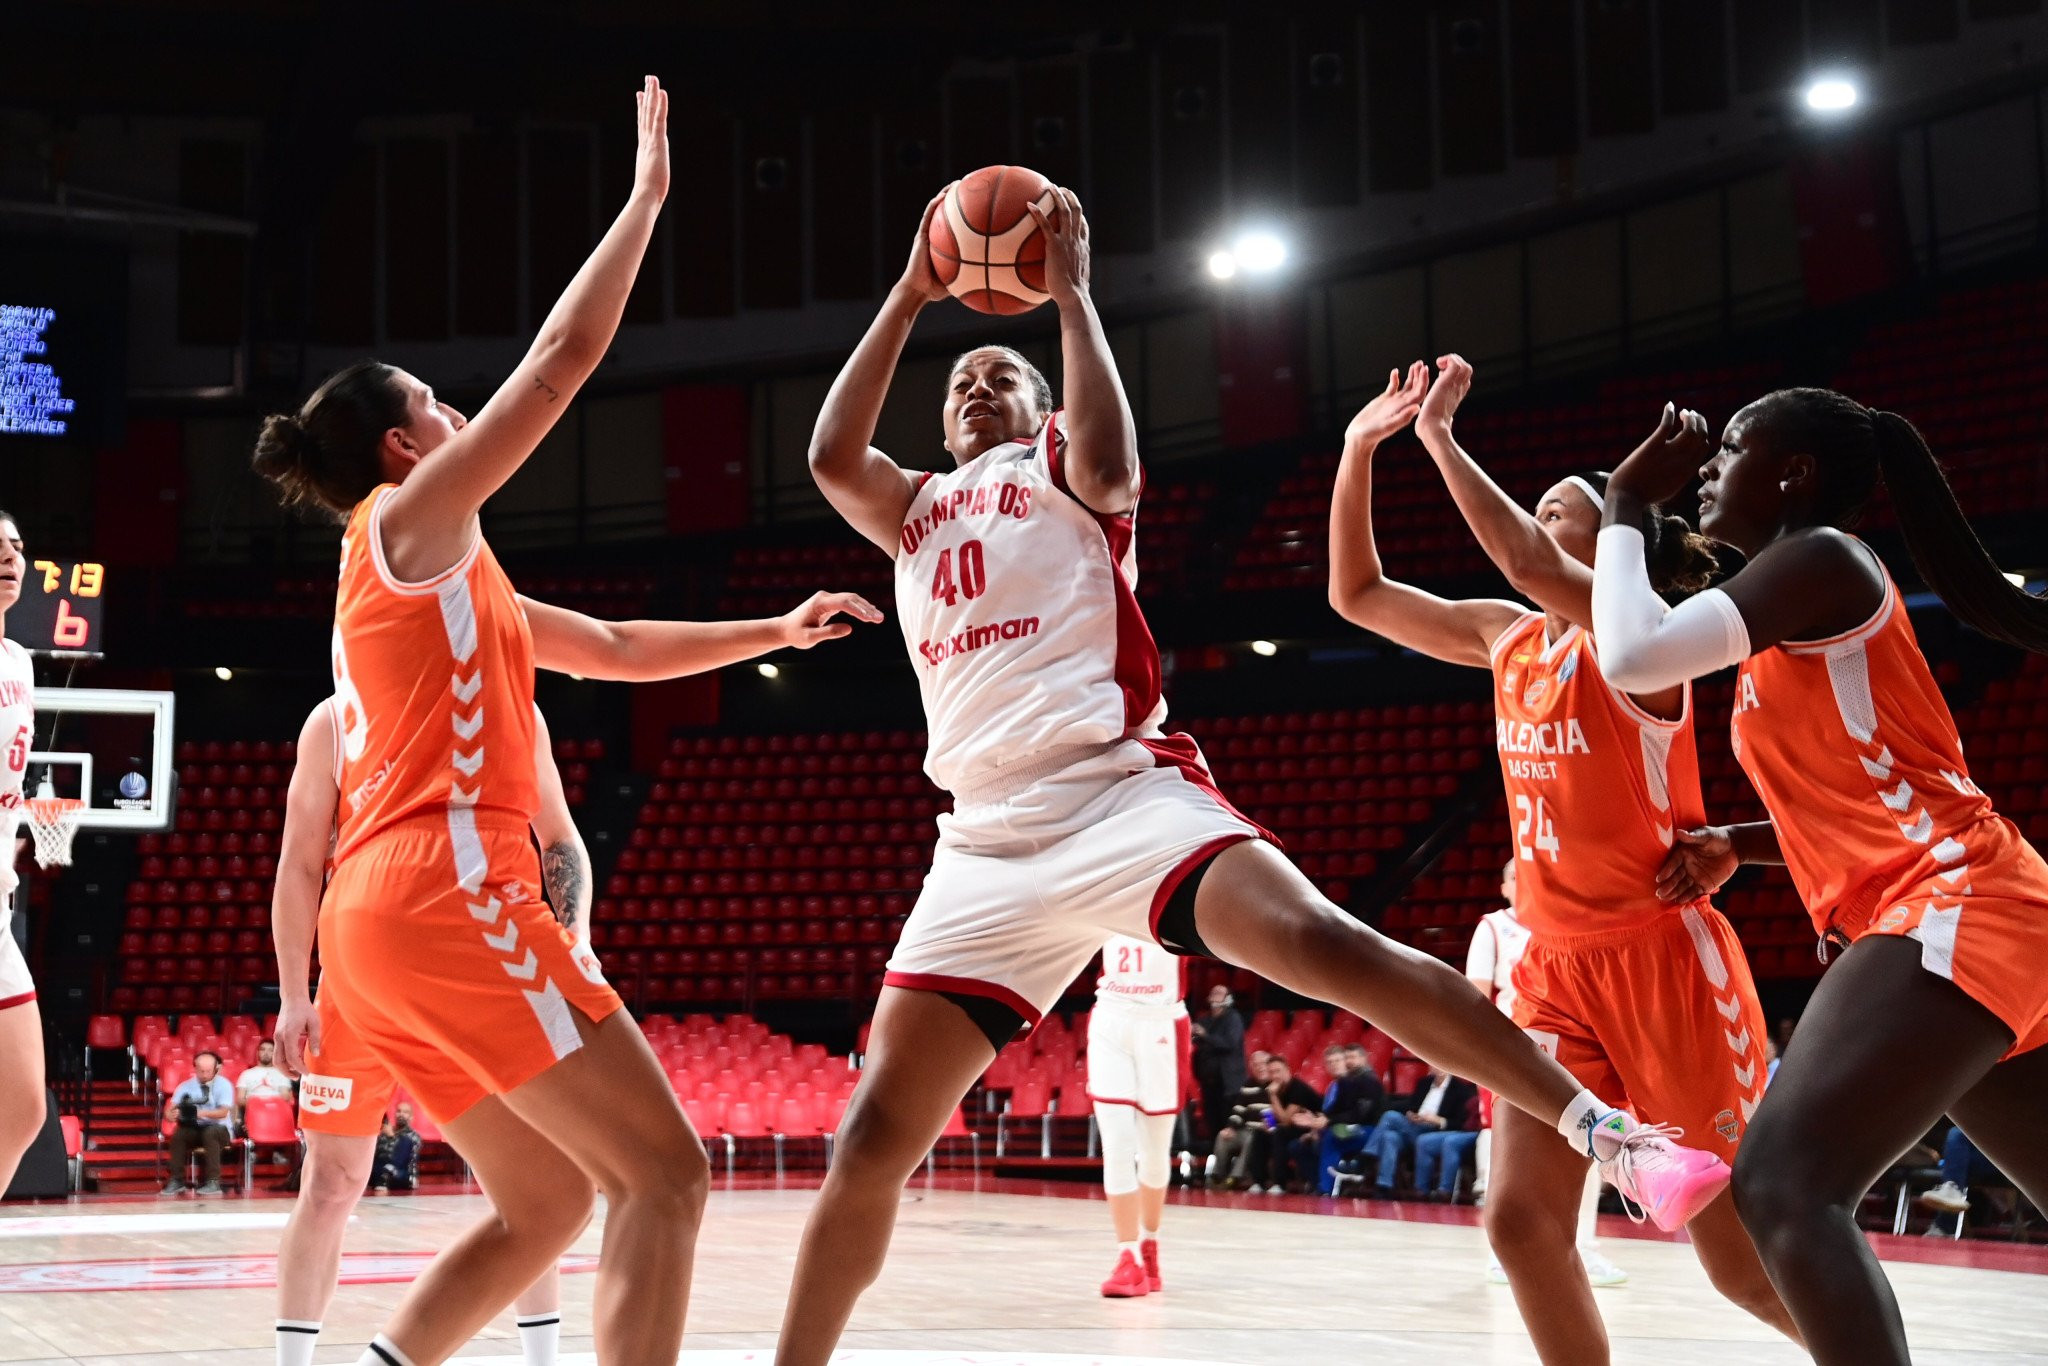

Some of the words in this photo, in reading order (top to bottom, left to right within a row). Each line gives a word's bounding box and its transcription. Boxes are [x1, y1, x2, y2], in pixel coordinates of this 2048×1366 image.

[0, 415, 67, 433] LEXANDER
[901, 481, 1032, 555] OLYMPIACOS
[34, 560, 104, 597] 7:13
[931, 540, 986, 607] 40
[54, 599, 88, 648] 6
[8, 724, 28, 772] 5
[1496, 717, 1591, 755] ALENCIA
[1508, 758, 1557, 780] BASKET
[1515, 794, 1560, 863] 24
[1118, 945, 1144, 973] 21
